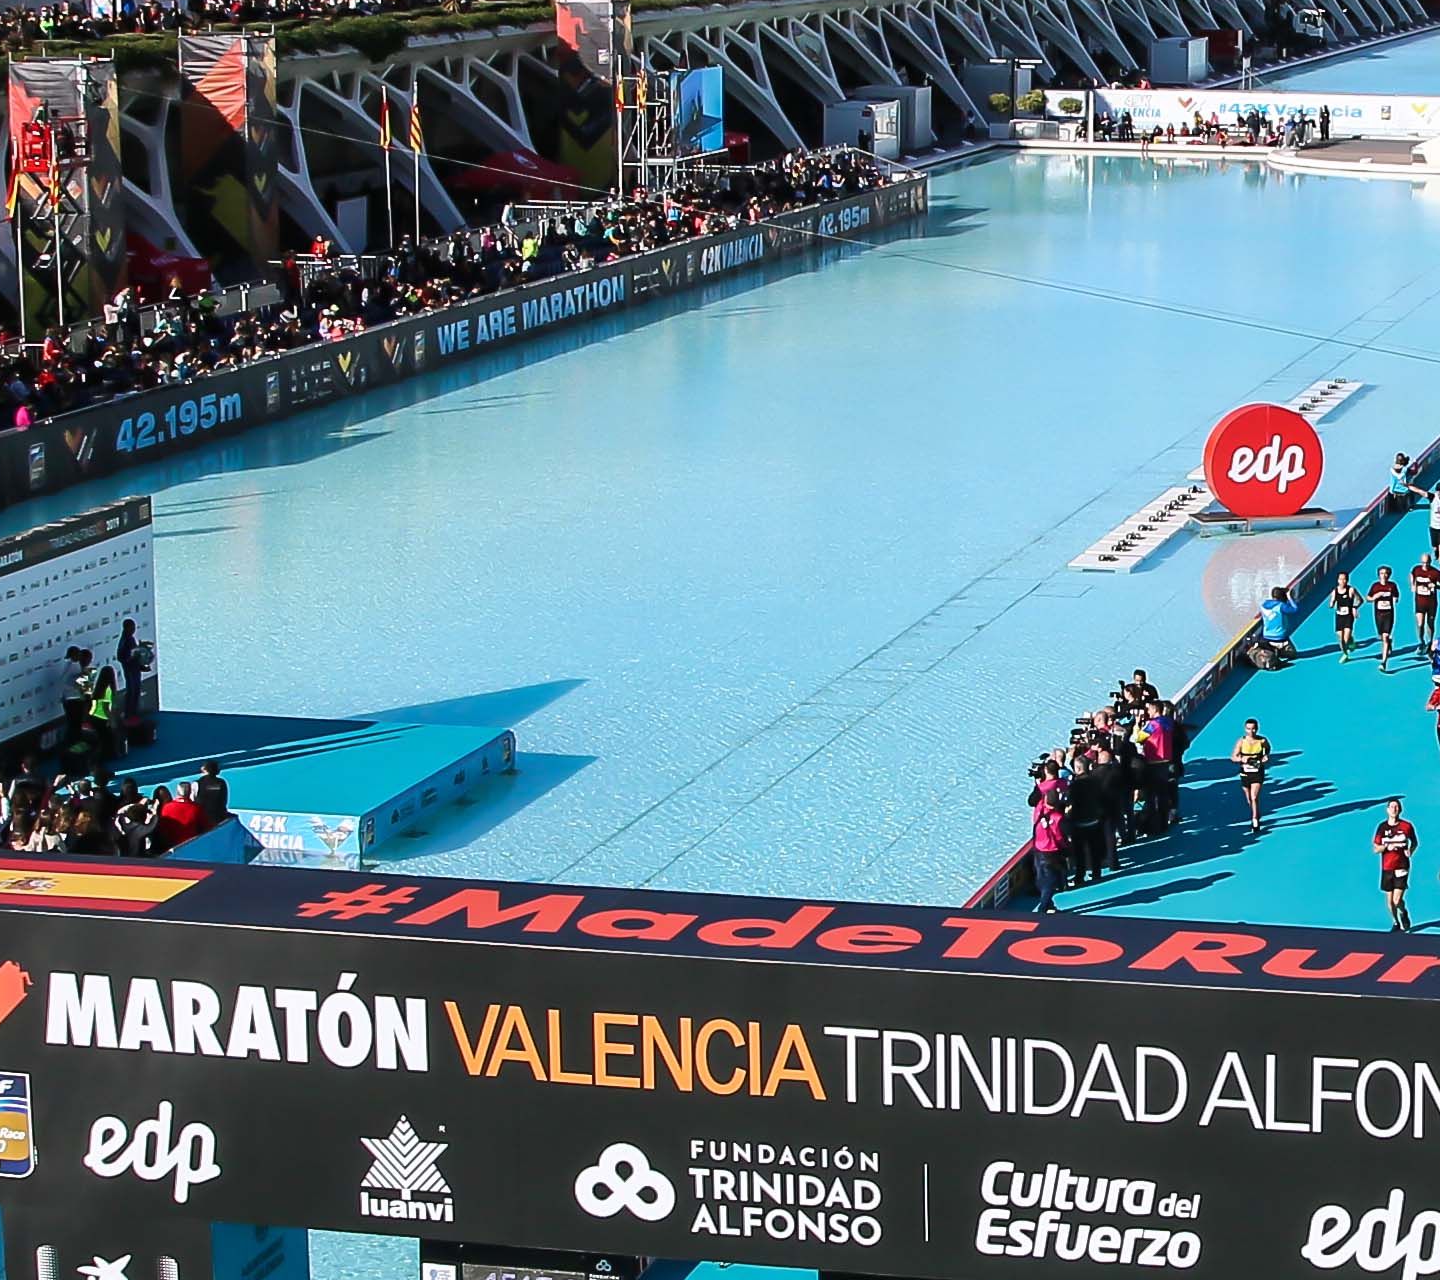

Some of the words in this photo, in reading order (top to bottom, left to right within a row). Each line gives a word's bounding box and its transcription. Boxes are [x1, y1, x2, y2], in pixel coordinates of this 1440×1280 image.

[437, 321, 469, 356] WE
[476, 306, 516, 345] ARE
[521, 274, 625, 331] MARATHON
[115, 390, 242, 454] 42.195m
[1226, 432, 1306, 493] edp
[249, 815, 289, 834] 42K
[44, 971, 428, 1074] MARATÓN
[441, 998, 827, 1103] VALENCIA
[822, 1023, 1189, 1125] TRINIDAD
[0, 1128, 25, 1141] Race
[83, 1100, 221, 1203] edp
[688, 1139, 881, 1173] FUNDACIÓN
[360, 1189, 454, 1224] luanvi
[688, 1166, 882, 1210] TRINIDAD
[982, 1161, 1154, 1216] Cultura
[1157, 1189, 1200, 1219] del
[689, 1201, 883, 1247] ALFONSO
[974, 1208, 1200, 1271] Esfuerzo
